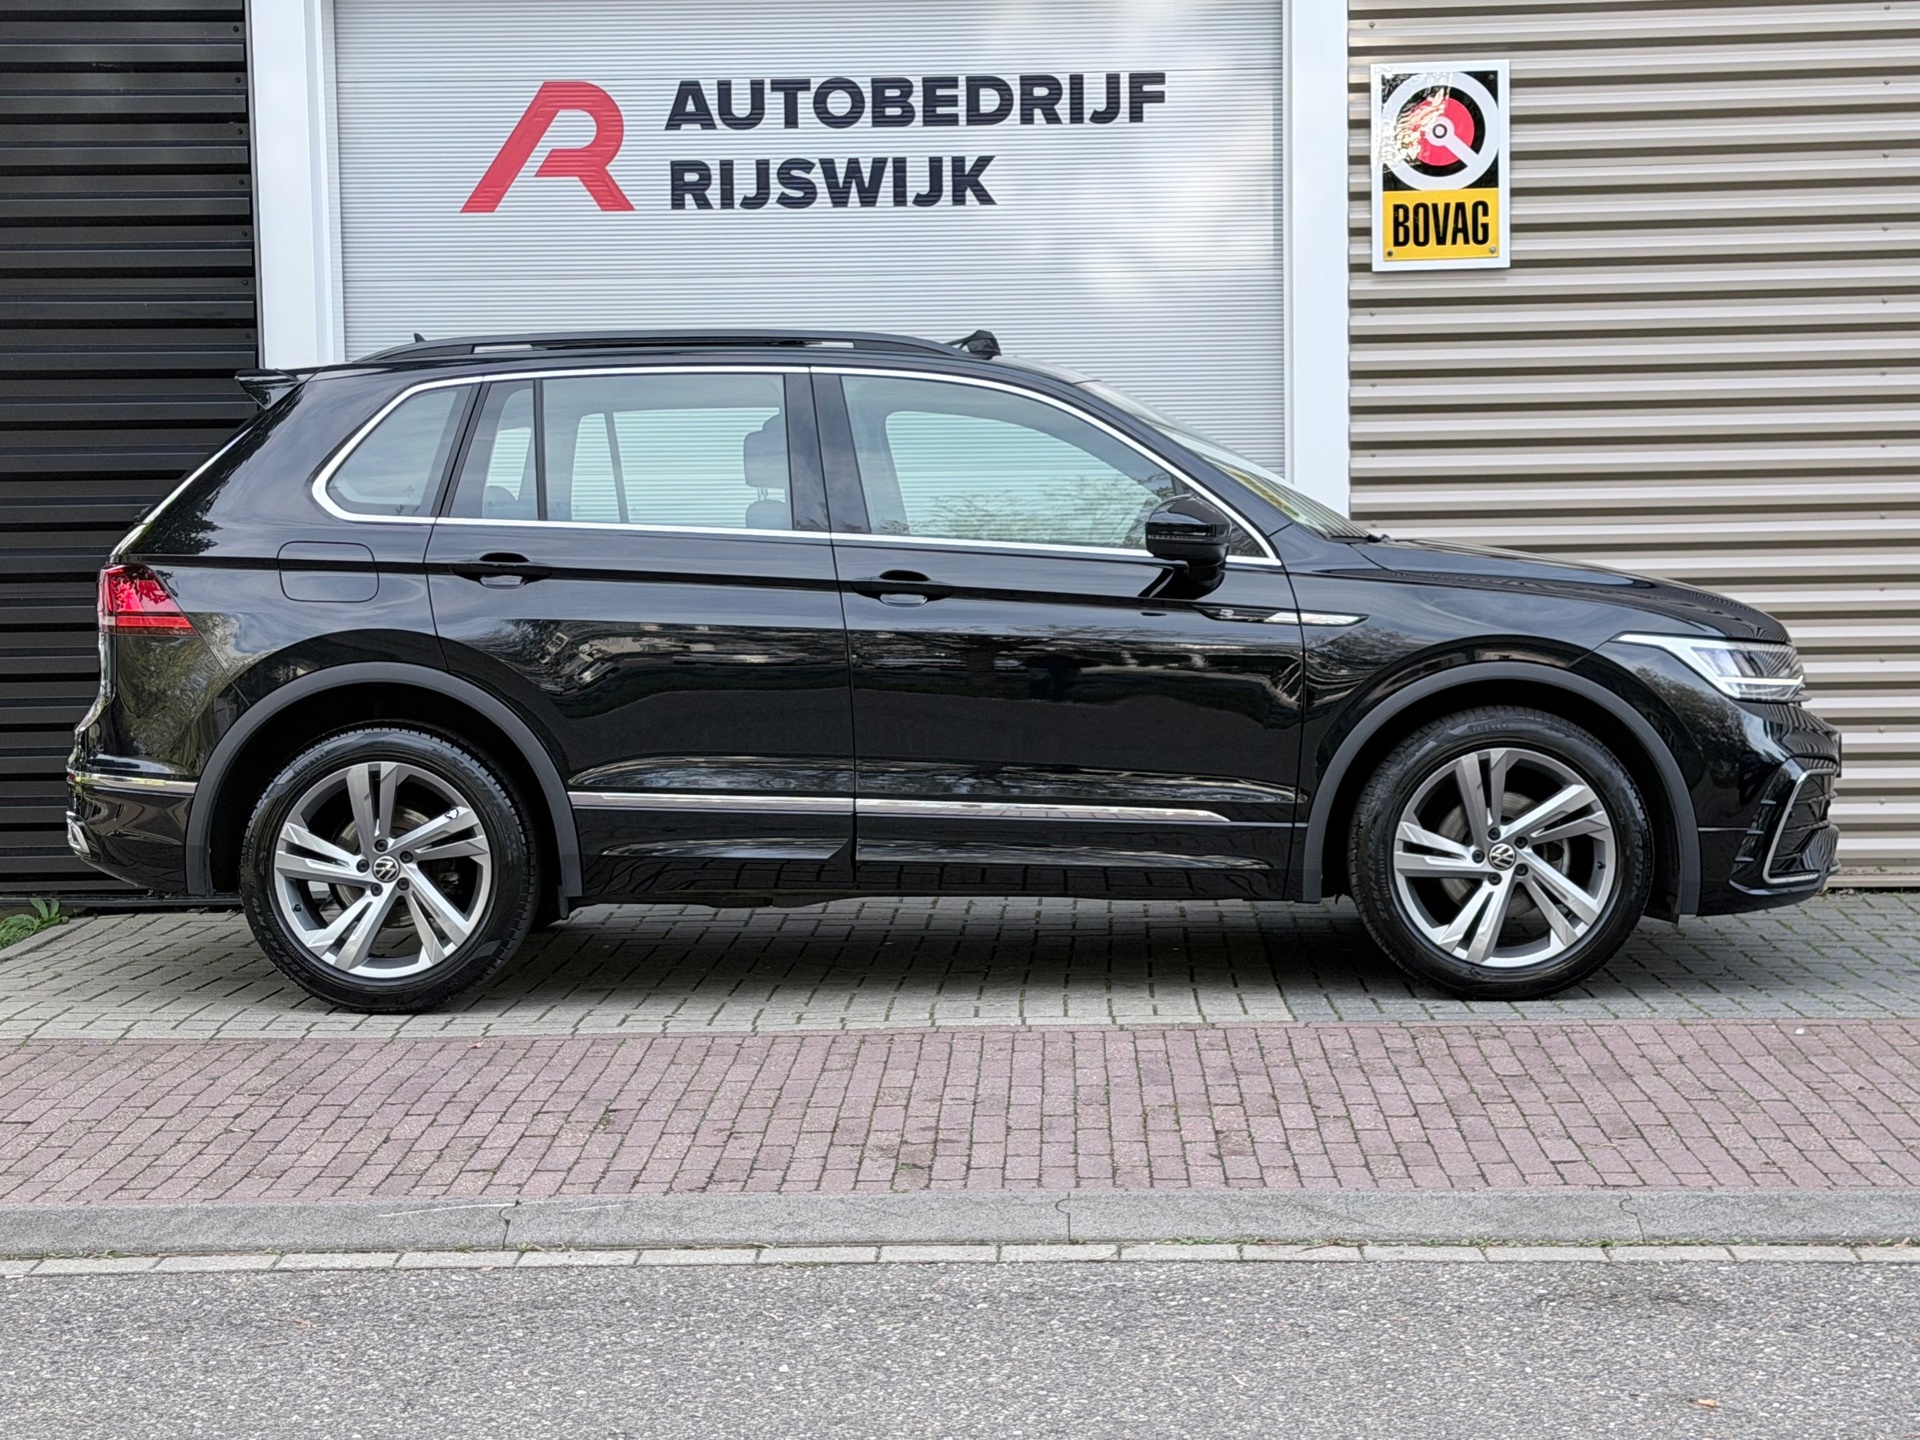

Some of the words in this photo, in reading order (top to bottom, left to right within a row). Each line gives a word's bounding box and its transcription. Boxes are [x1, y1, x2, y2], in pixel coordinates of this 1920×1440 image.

[665, 73, 1165, 130] AUTOBEDRIJF
[671, 156, 996, 209] RIJSWIJK
[1393, 201, 1488, 246] BOVAG
